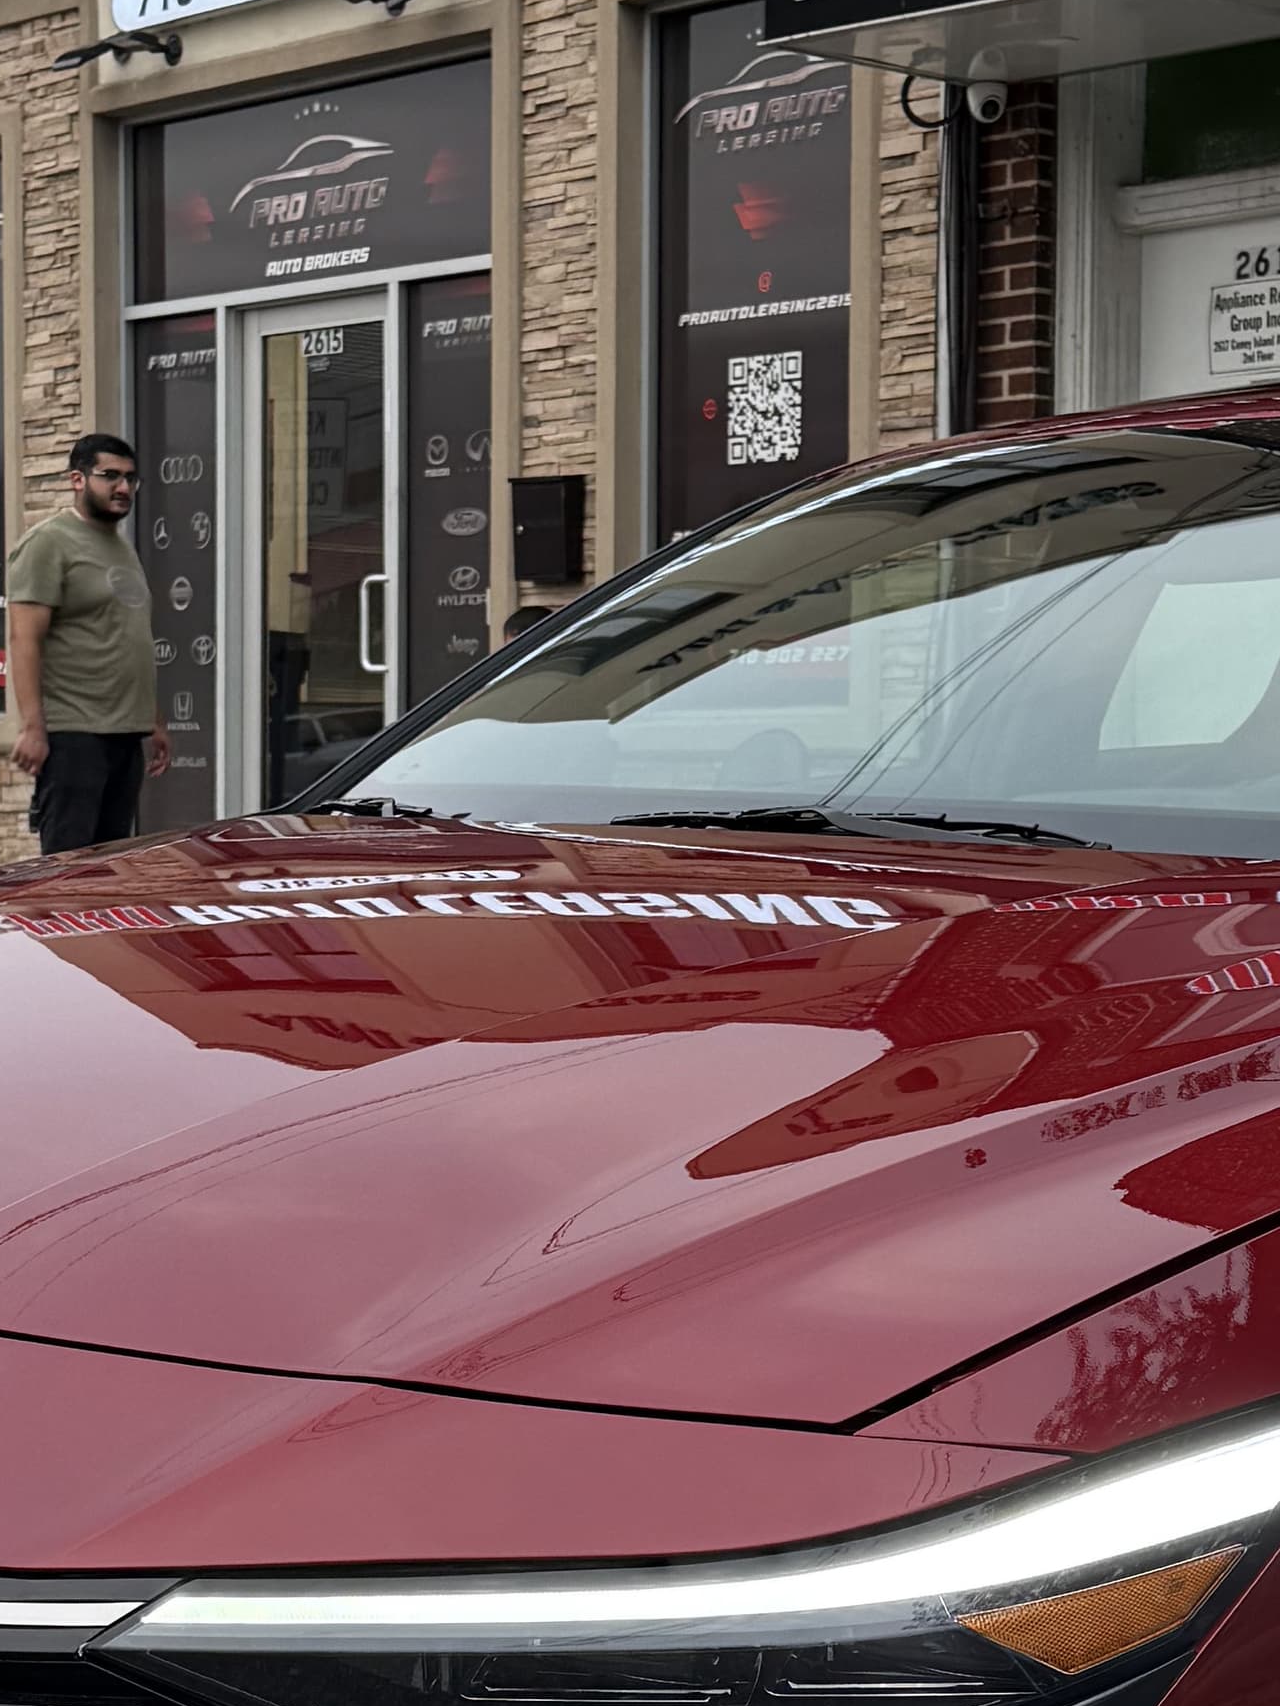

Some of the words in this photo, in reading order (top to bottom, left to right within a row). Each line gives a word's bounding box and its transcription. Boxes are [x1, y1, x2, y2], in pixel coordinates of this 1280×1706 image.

[695, 101, 760, 138] PRO
[762, 85, 848, 125] AUTO
[249, 191, 308, 229] PRO
[311, 177, 389, 218] AUTO
[265, 257, 303, 277] AUTO
[303, 247, 371, 272] BROKERS
[1215, 291, 1266, 314] Appliance
[1230, 314, 1263, 333] Group
[303, 327, 342, 355] 2615
